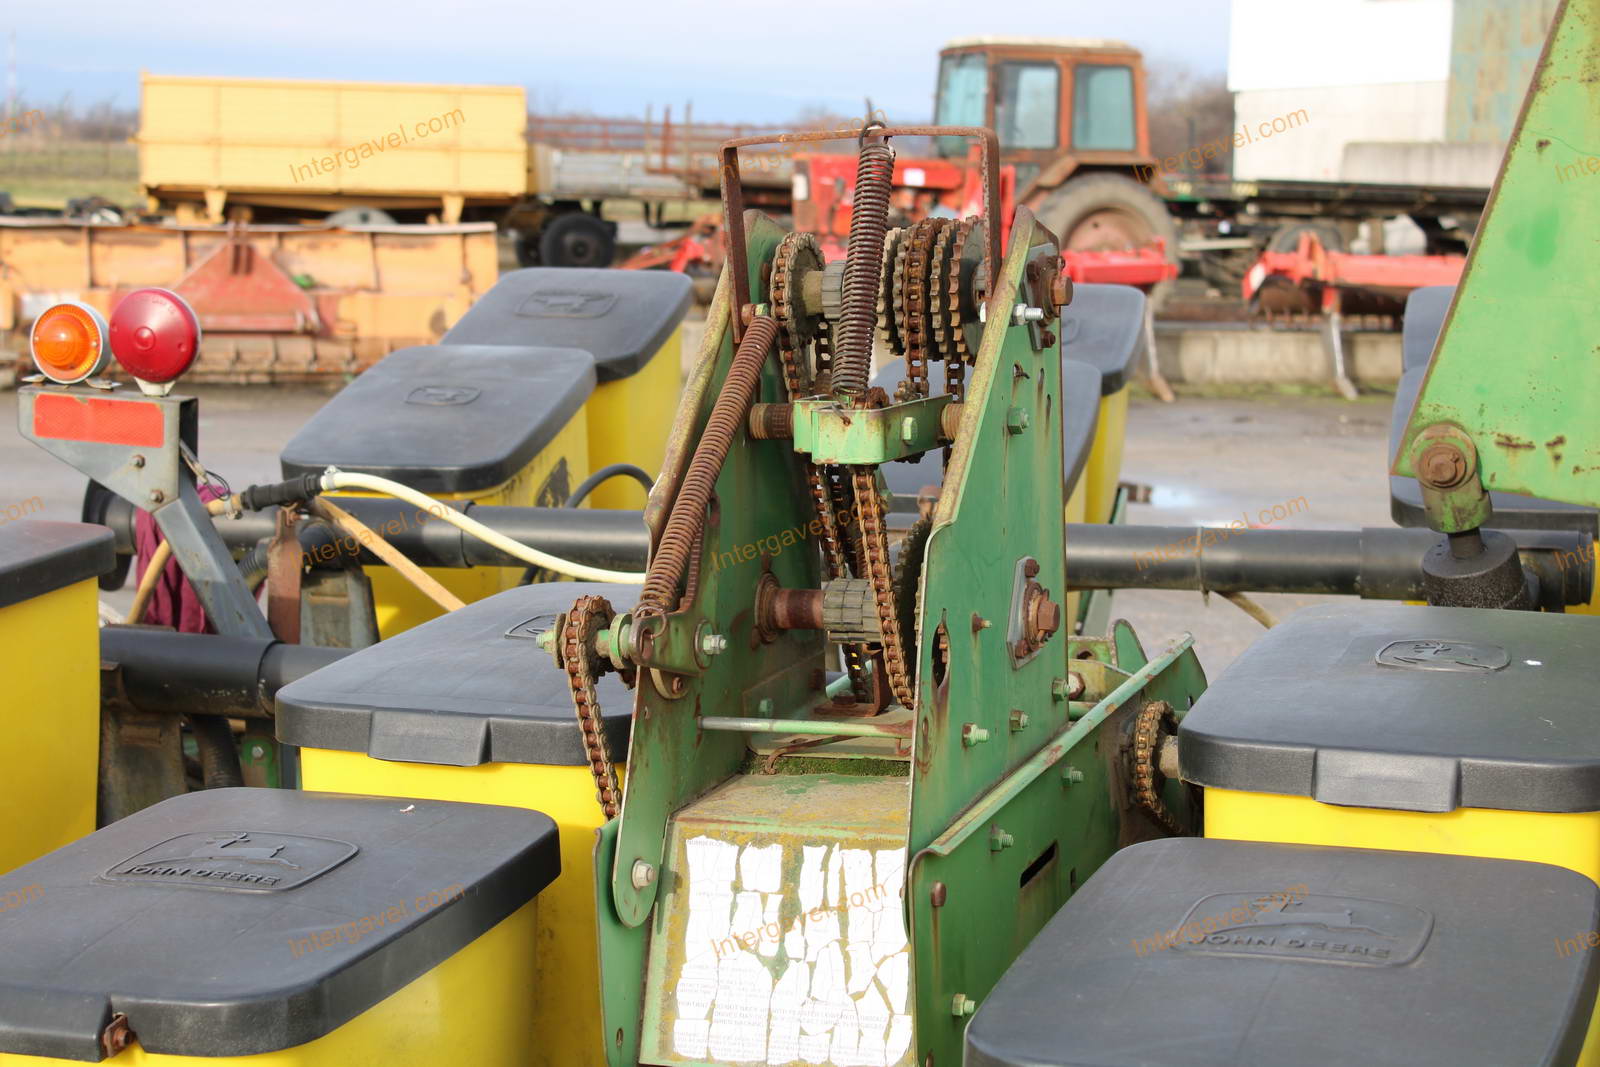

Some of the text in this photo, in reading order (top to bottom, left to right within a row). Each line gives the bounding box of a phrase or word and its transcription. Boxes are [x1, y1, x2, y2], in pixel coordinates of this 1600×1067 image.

[116, 866, 281, 886] JOHN DEERE
[1187, 934, 1392, 960] JOHN DEERE
